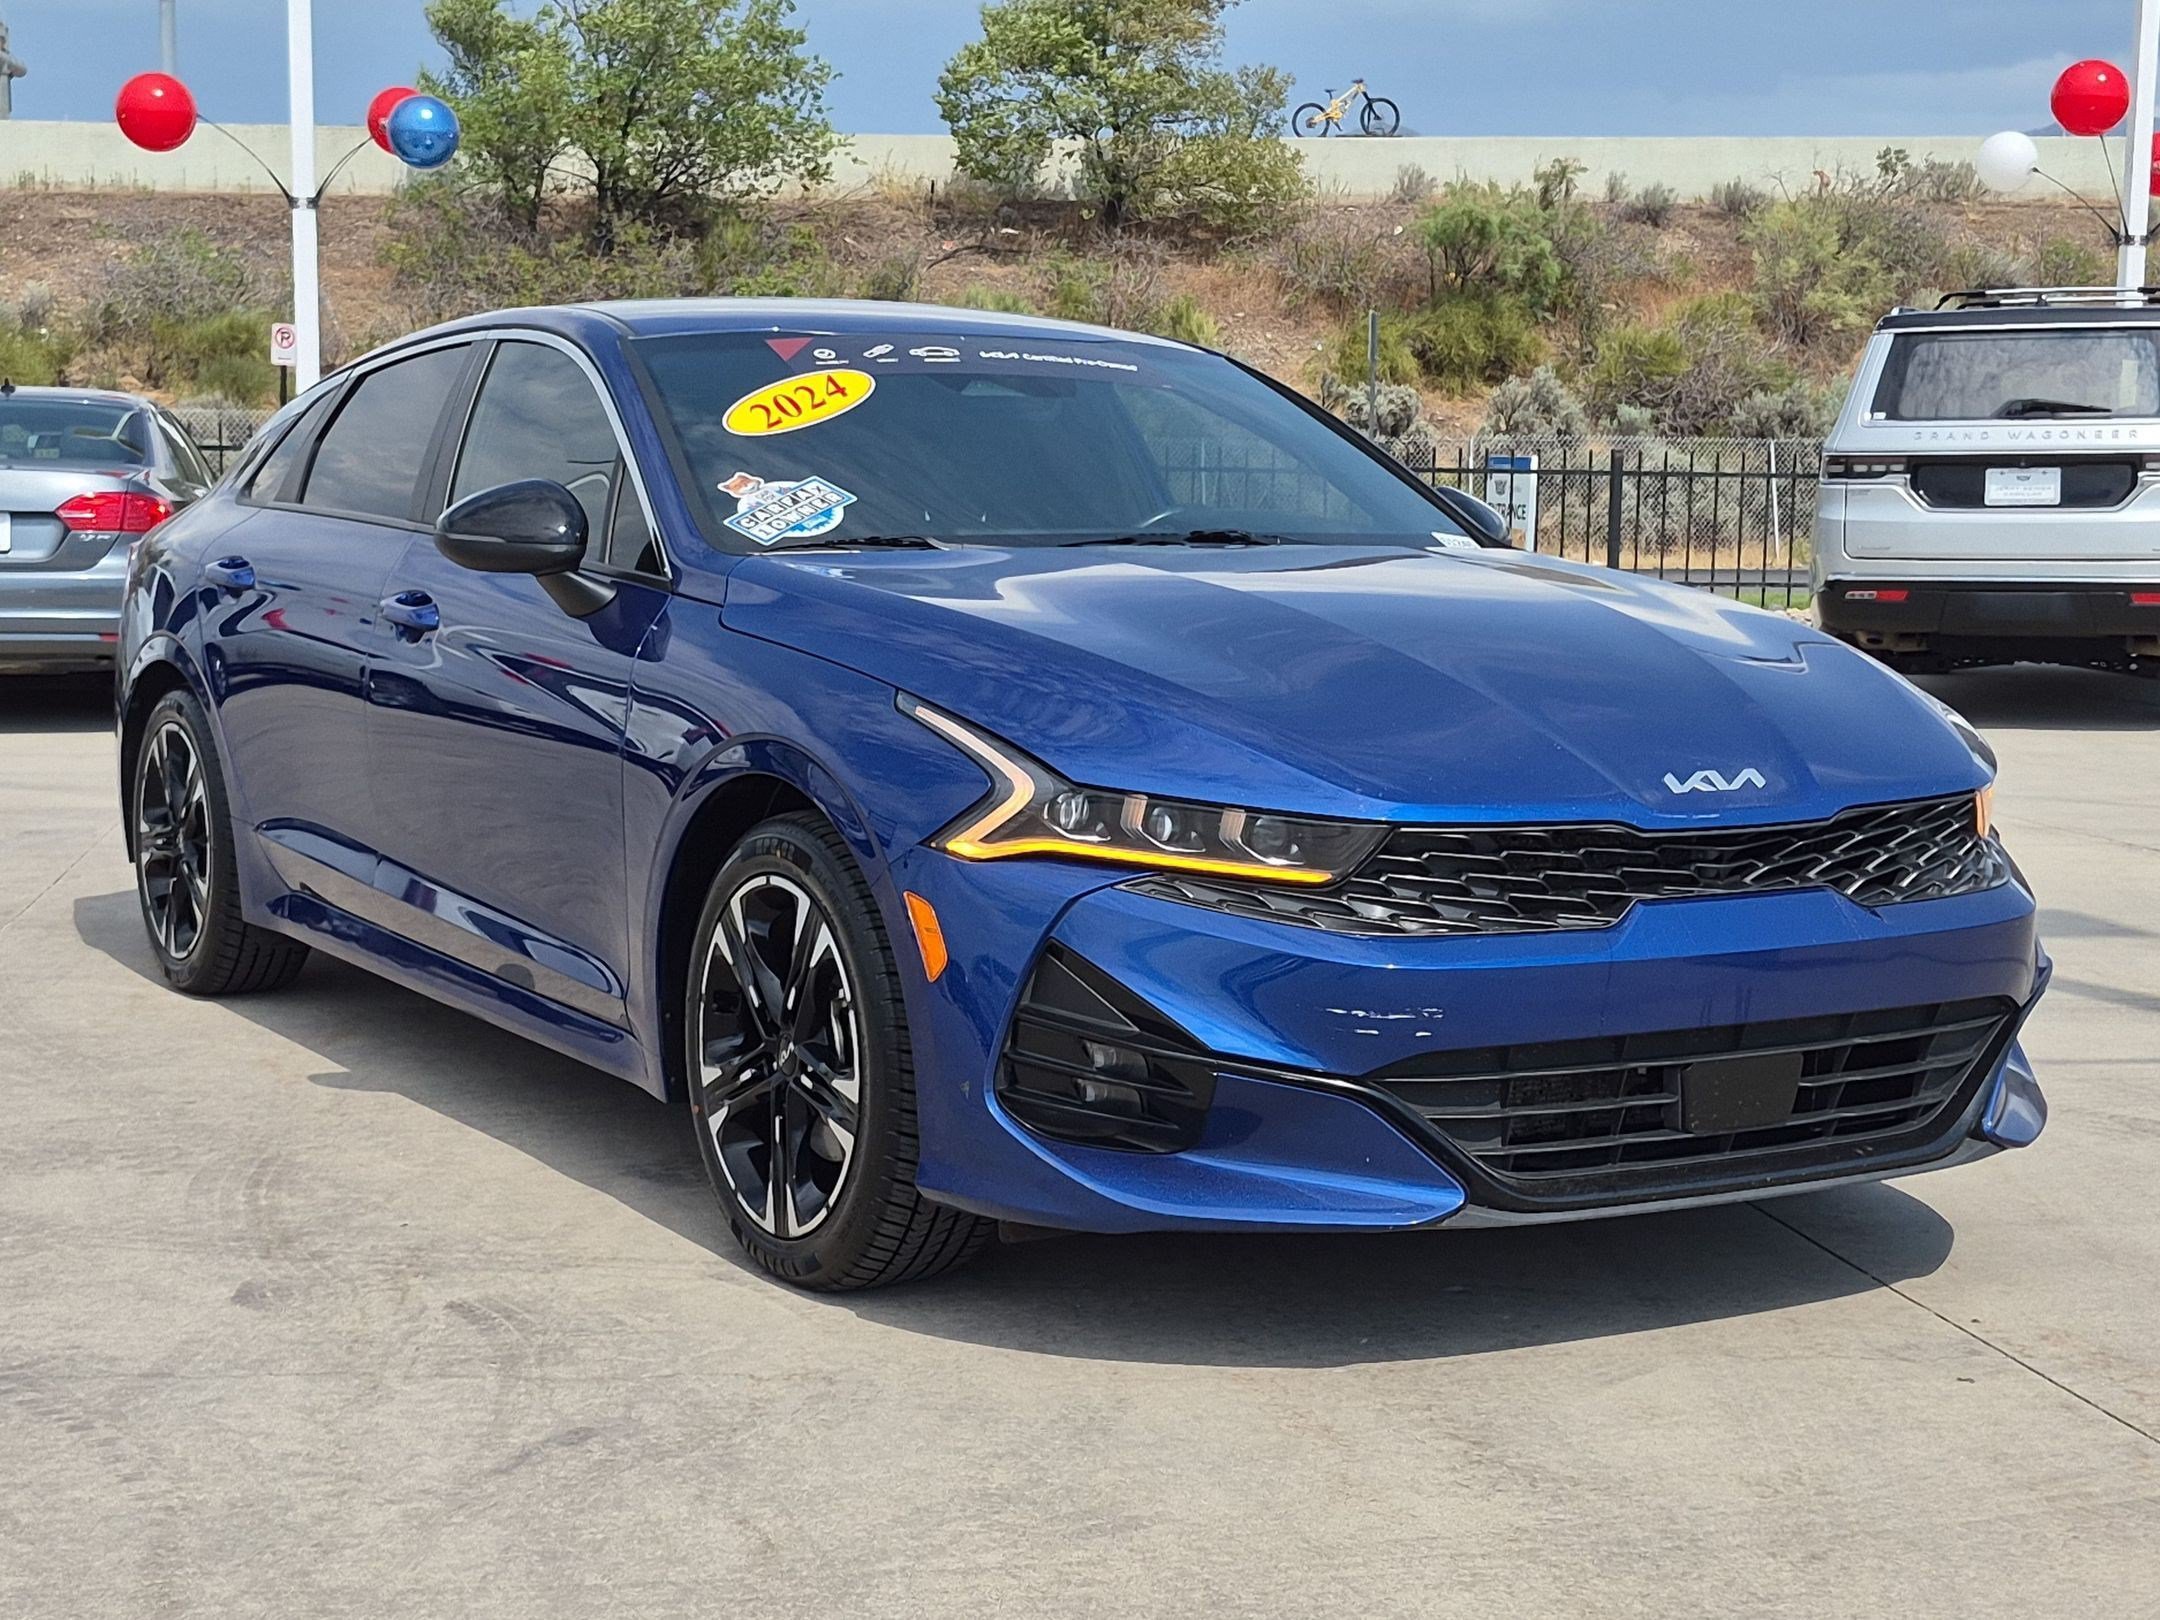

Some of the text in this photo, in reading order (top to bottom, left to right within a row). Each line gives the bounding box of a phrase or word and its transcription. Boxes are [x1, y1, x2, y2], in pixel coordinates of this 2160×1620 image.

[750, 374, 849, 430] 2024
[1913, 429, 2139, 441] GRAND WAGONEER
[736, 486, 826, 530] CARFAX
[1663, 767, 1767, 794] KIA
